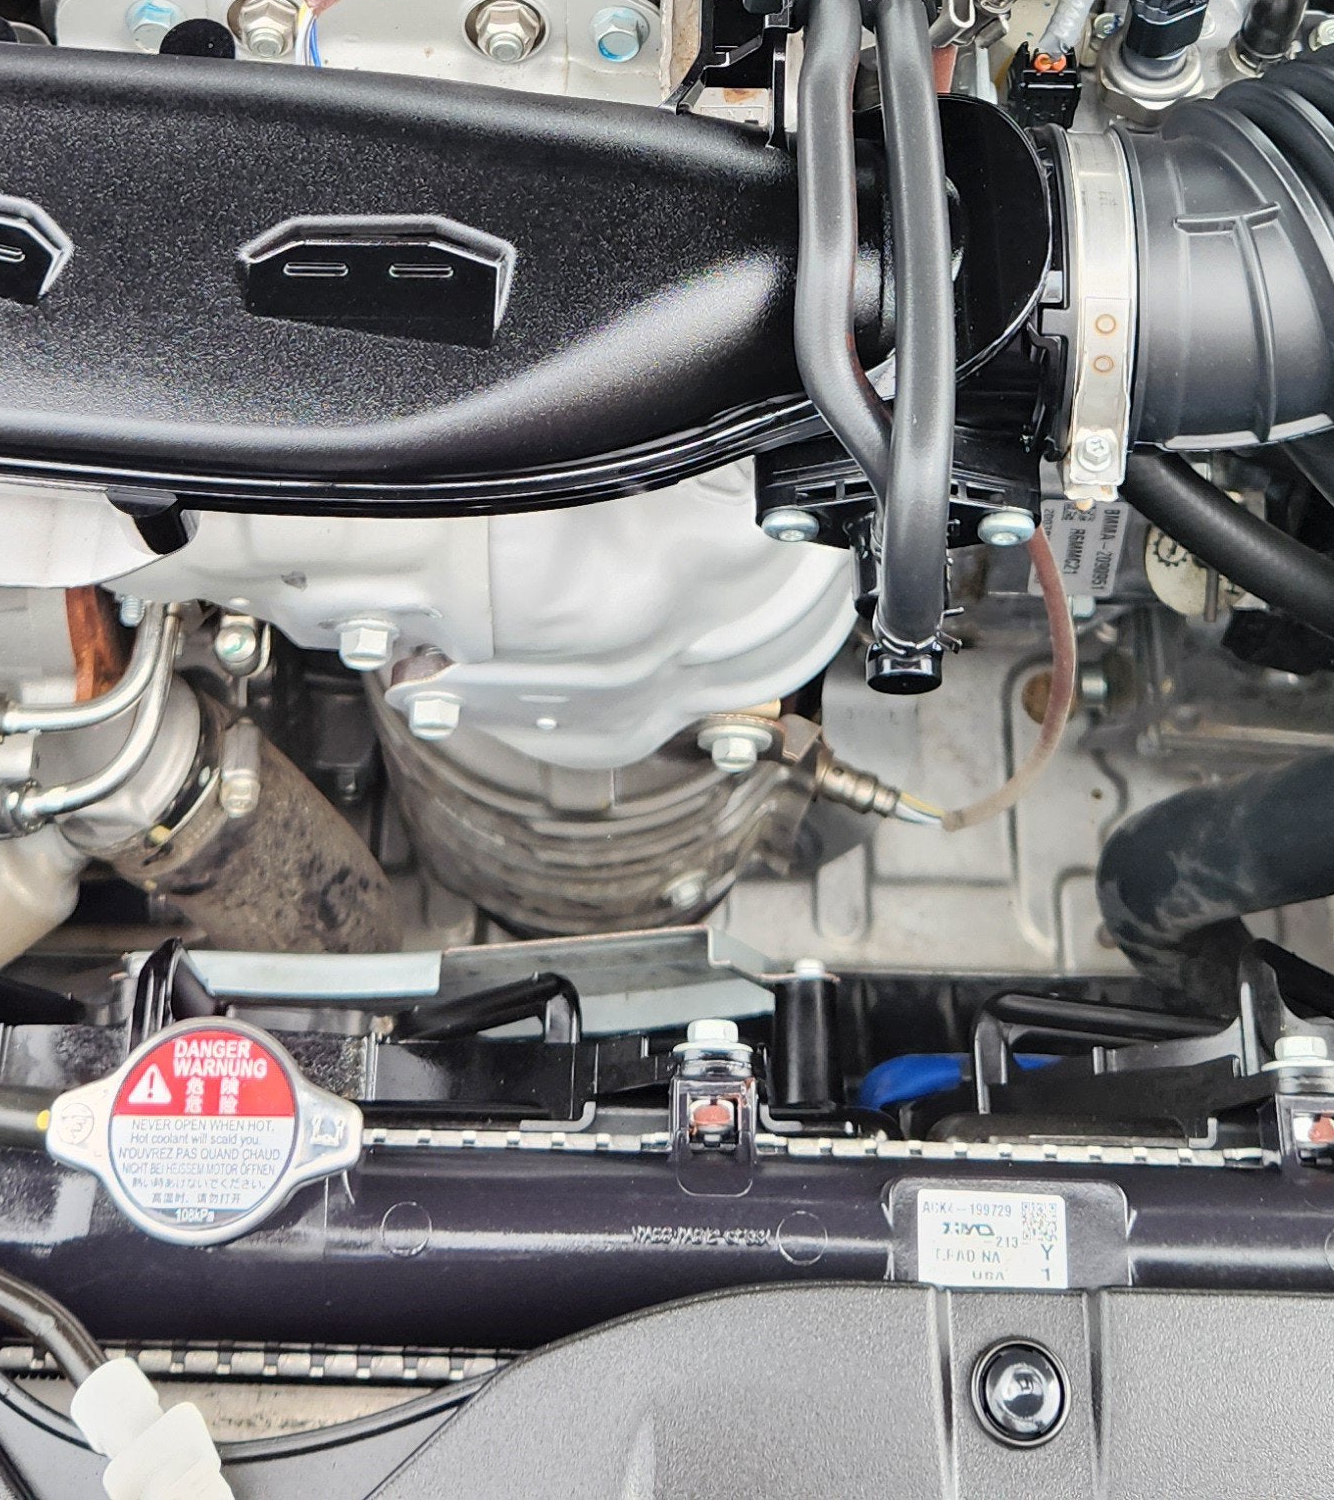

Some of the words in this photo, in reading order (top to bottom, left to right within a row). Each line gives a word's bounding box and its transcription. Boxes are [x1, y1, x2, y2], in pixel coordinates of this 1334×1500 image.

[174, 1039, 252, 1059] DANGER
[172, 1058, 268, 1079] WARNUNG
[132, 1119, 171, 1131] NEVER
[174, 1119, 207, 1131] OPEN
[210, 1119, 244, 1131] WHEN
[130, 1134, 149, 1145] Hot
[151, 1134, 188, 1145] coolant
[191, 1134, 208, 1145] will
[210, 1134, 237, 1145] scald
[176, 1148, 198, 1160] PAS
[200, 1148, 240, 1161] QUAND
[242, 1149, 281, 1161] CHAUD
[122, 1162, 148, 1174] NICHT
[207, 1162, 238, 1175] MOTOR
[175, 1208, 216, 1222] 108kPa
[1041, 1243, 1054, 1261] Y
